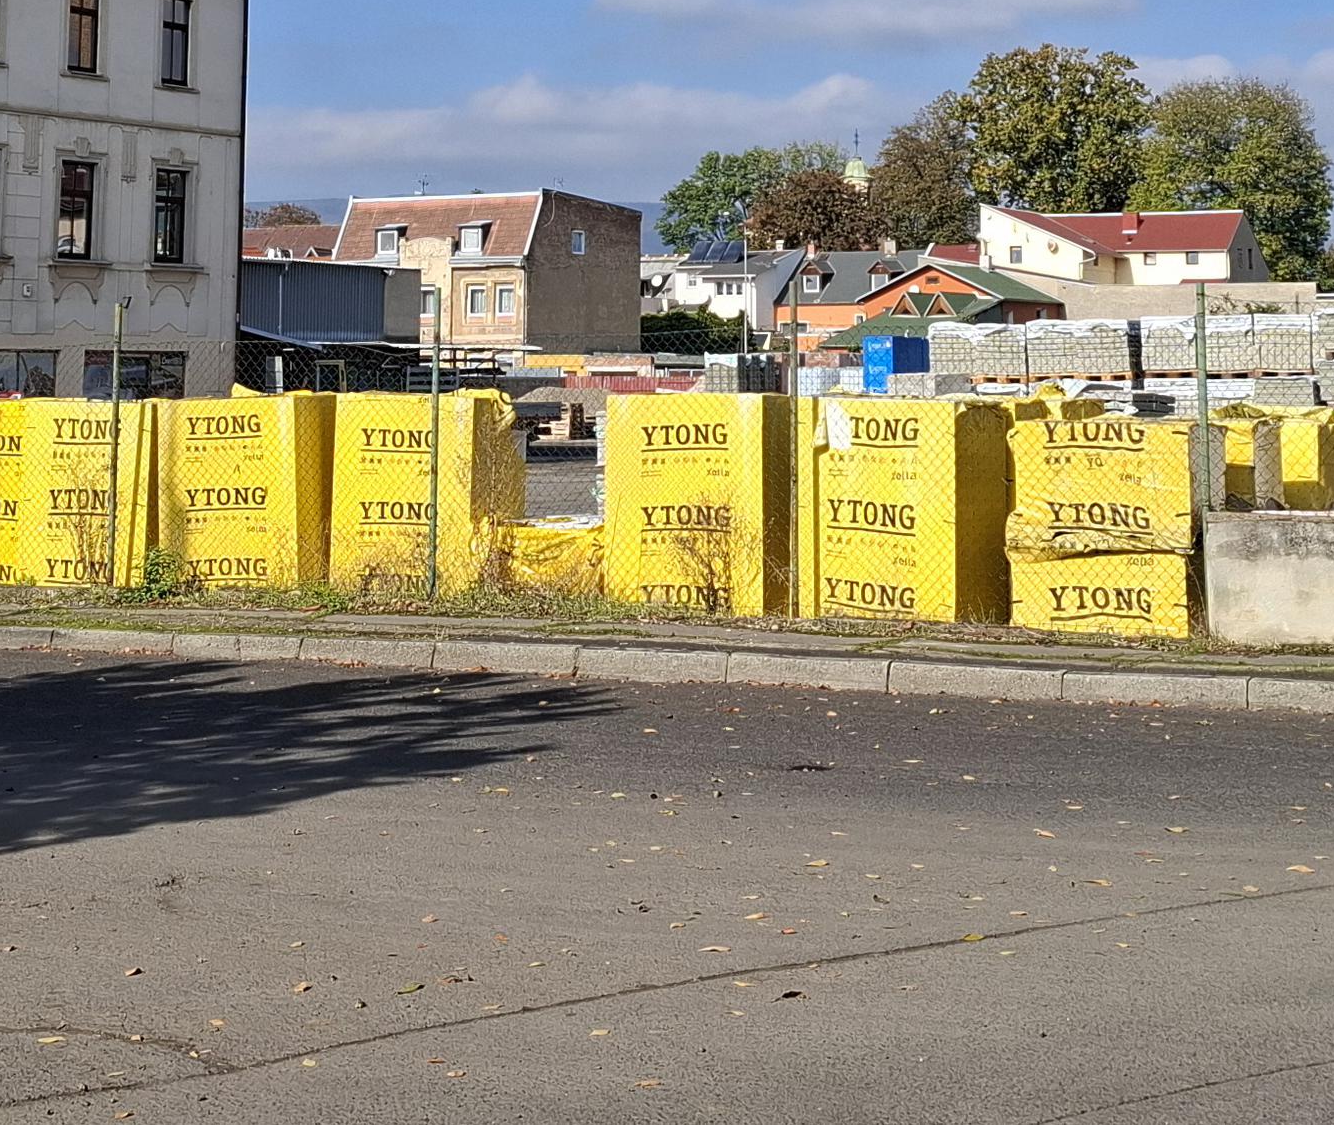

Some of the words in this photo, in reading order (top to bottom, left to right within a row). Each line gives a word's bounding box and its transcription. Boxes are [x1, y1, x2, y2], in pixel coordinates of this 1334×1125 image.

[187, 414, 262, 435] YTONG
[641, 423, 728, 446] YTONG
[849, 416, 920, 441] TONG
[1044, 421, 1145, 444] YTONG
[49, 488, 113, 510] YTON
[185, 486, 267, 507] YTONG
[641, 505, 732, 527] YTONG
[827, 498, 917, 530] YTONG
[1047, 501, 1151, 530] YTONG
[46, 558, 109, 581] YTON
[187, 557, 268, 576] YTONG
[824, 577, 916, 609] YTONG
[1049, 586, 1152, 614] YTONG
